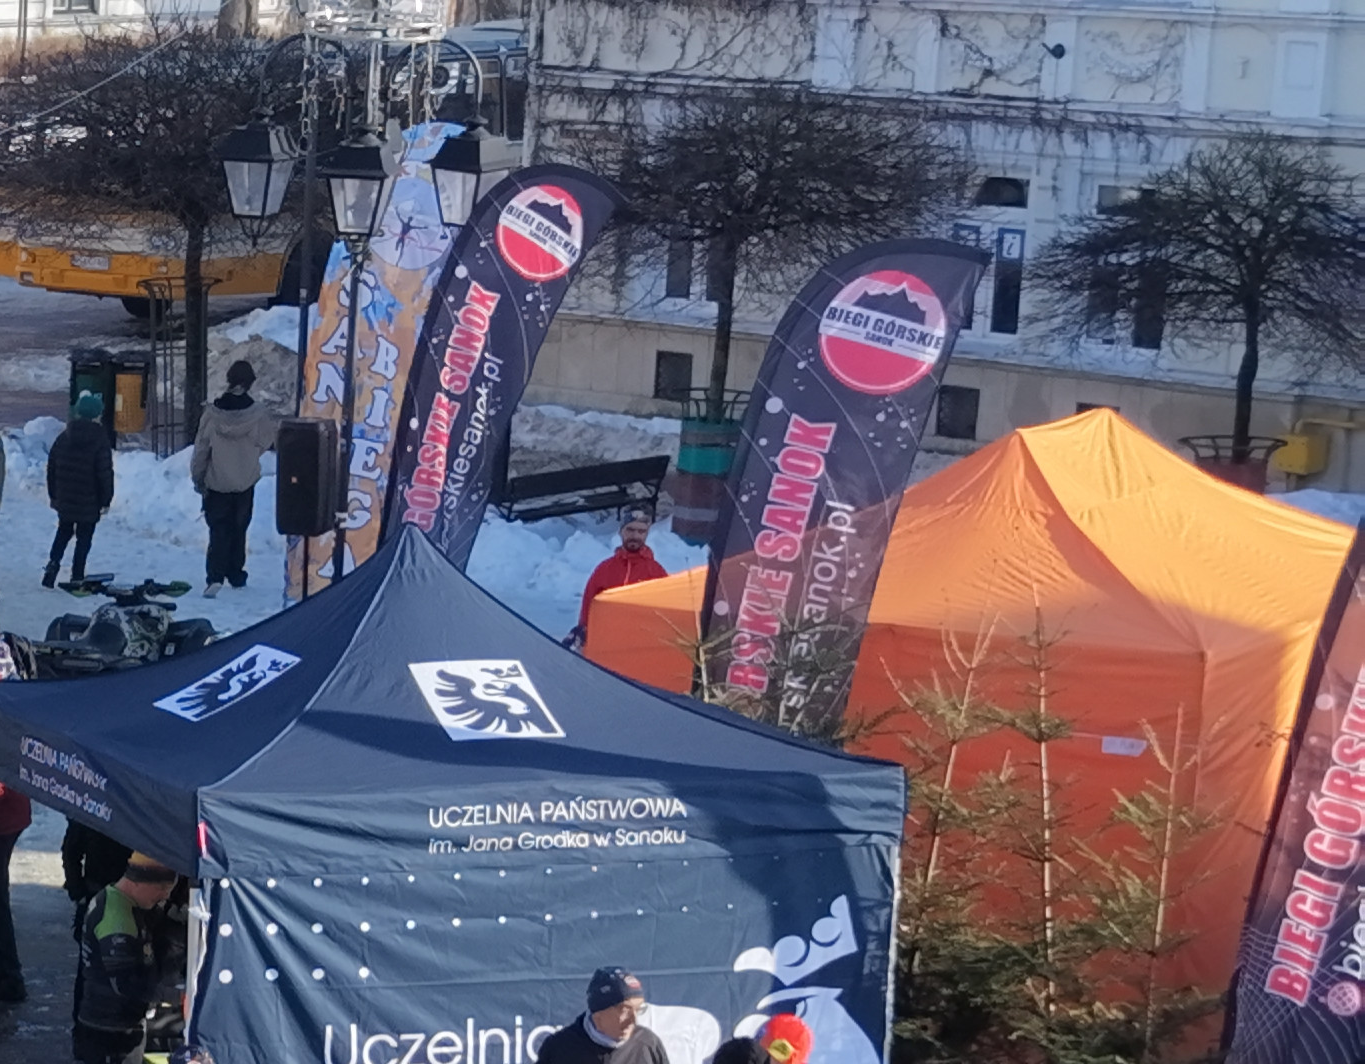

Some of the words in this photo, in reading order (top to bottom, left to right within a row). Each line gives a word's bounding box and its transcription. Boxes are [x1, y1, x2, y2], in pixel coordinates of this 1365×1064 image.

[825, 306, 870, 330] BIEGI
[871, 315, 945, 351] GÓRSKIE
[428, 801, 535, 828] UCZELNIA
[540, 796, 688, 823] PAŃSTWOWA
[427, 837, 457, 855] im.
[460, 835, 513, 853] Jana
[517, 829, 590, 850] Grodka
[593, 832, 612, 848] w
[614, 827, 687, 847] Sanoku
[1265, 867, 1345, 1008] BIEGI
